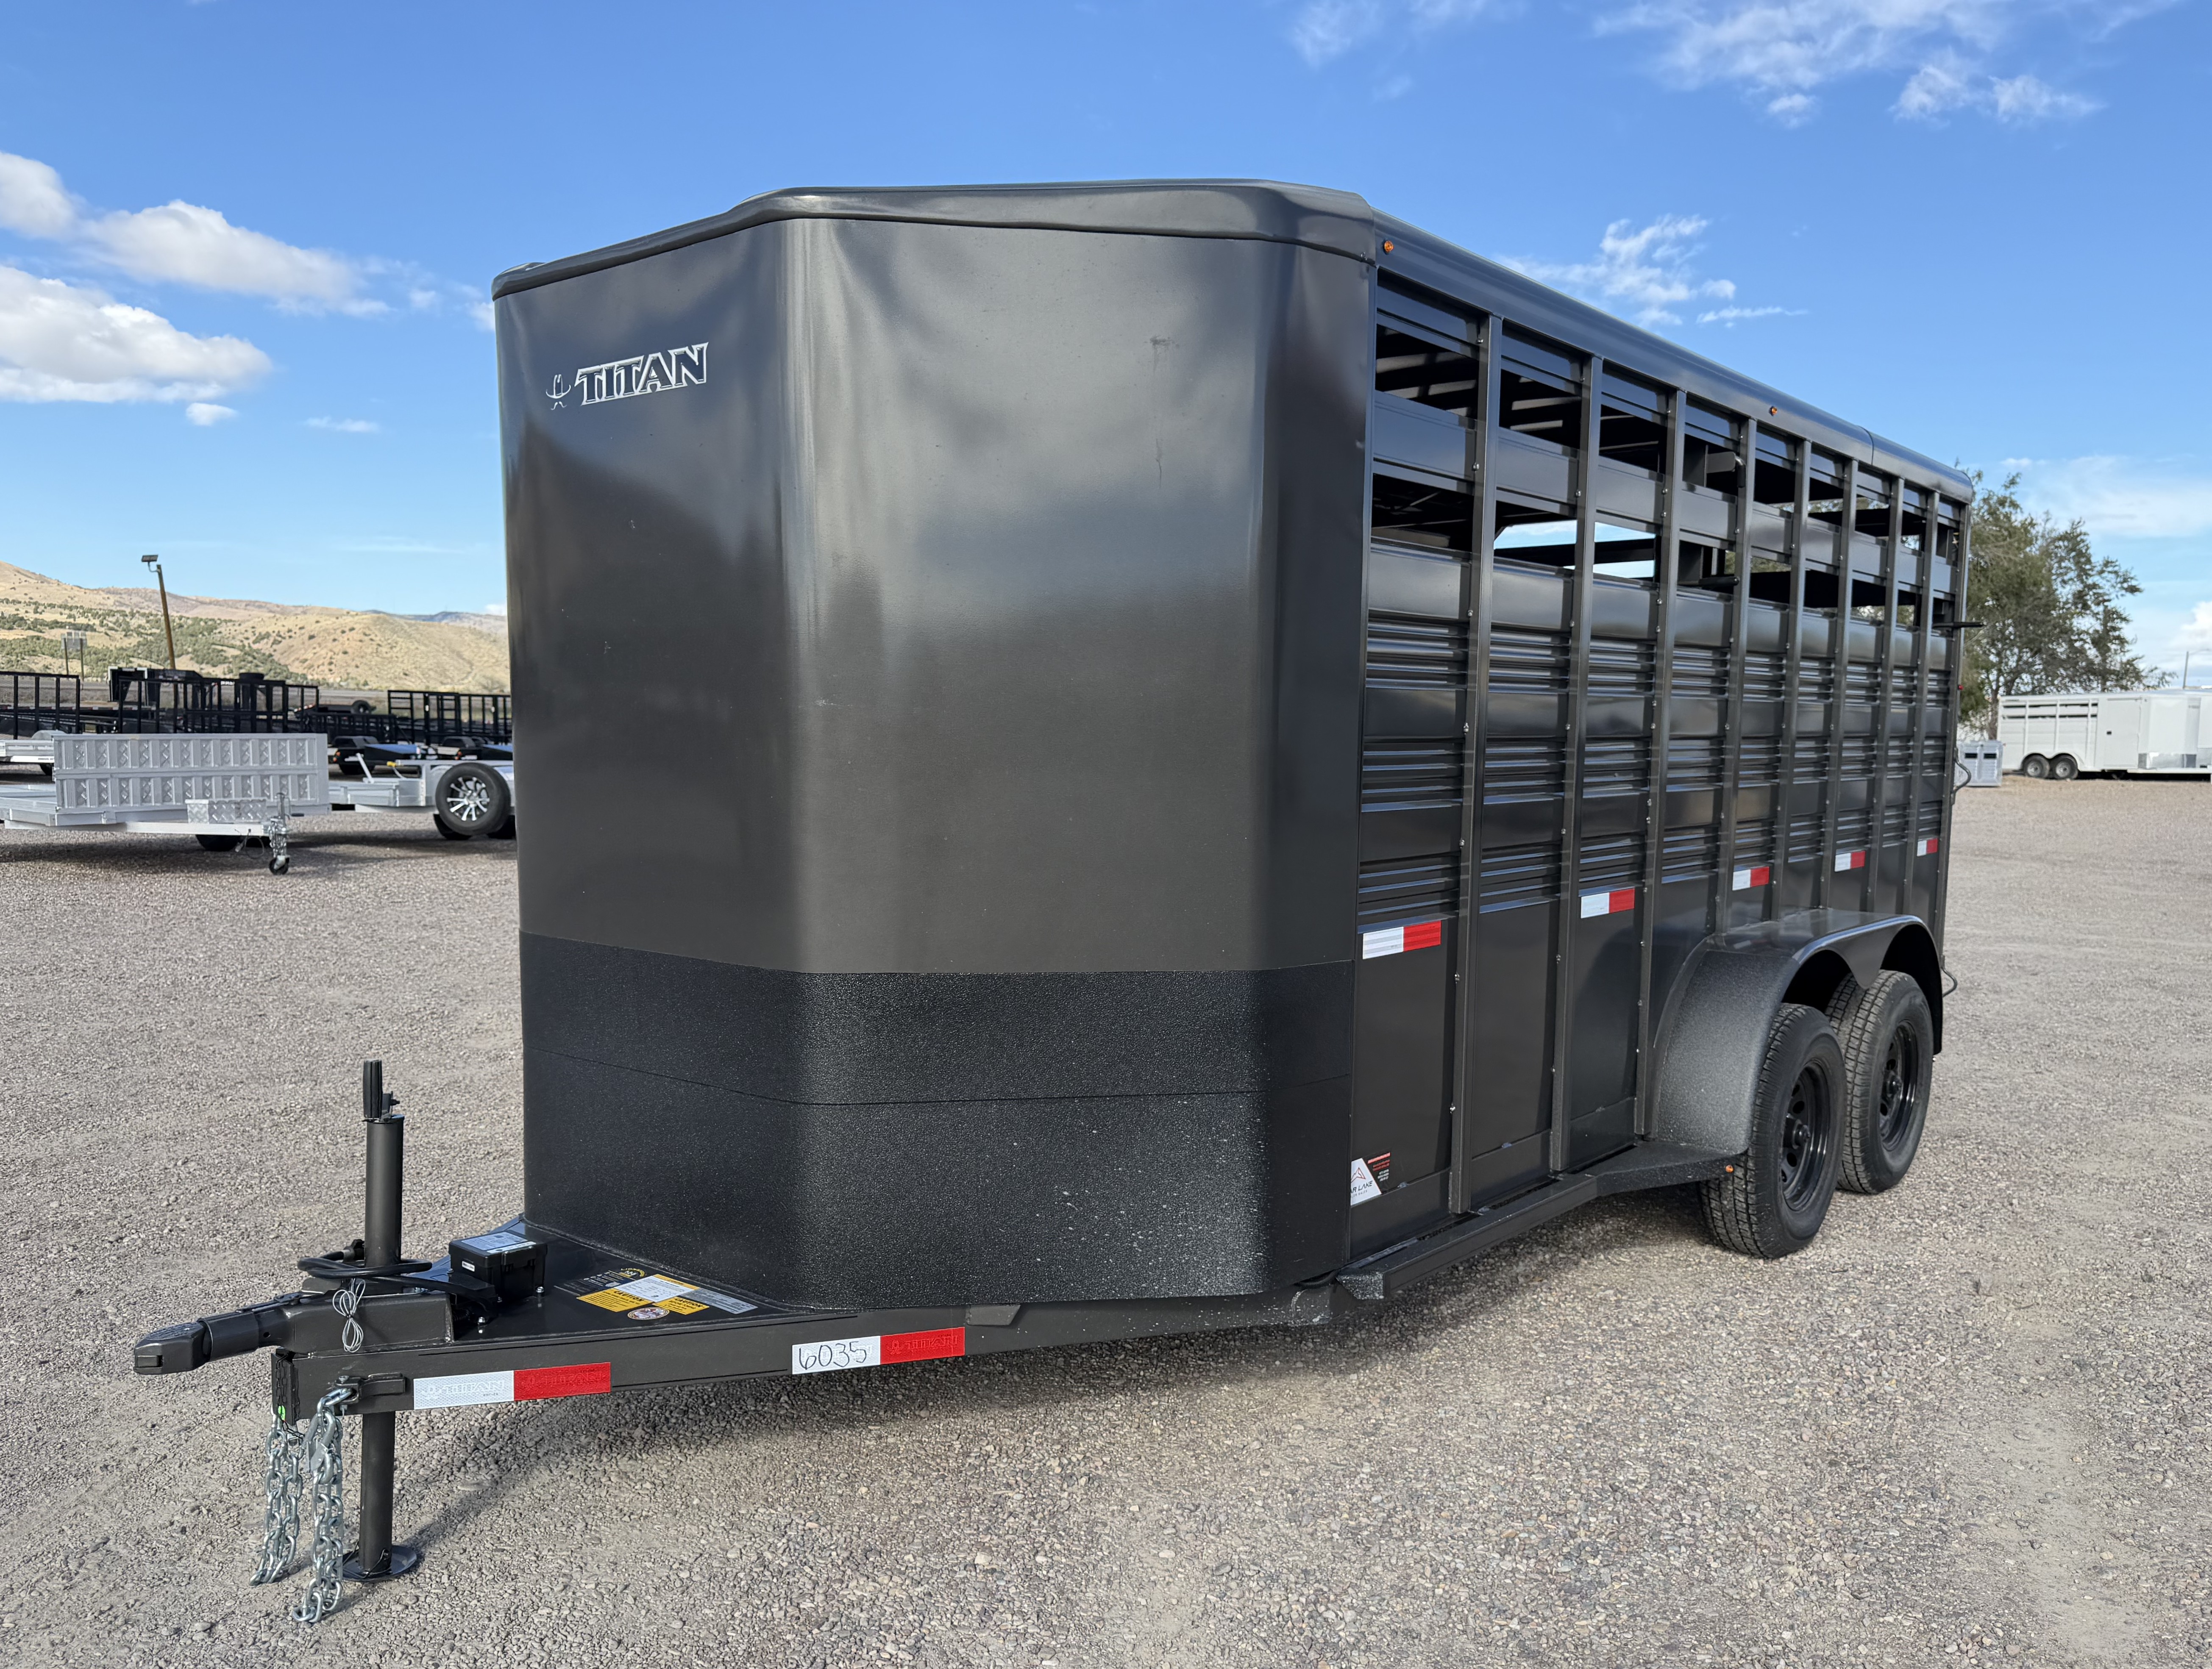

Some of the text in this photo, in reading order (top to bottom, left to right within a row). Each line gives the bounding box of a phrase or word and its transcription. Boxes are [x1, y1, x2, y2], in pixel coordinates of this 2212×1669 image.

[574, 342, 709, 406] TITAN
[1358, 1180, 1373, 1191] LAKE
[613, 1291, 645, 1302] CAUTION
[674, 1298, 704, 1308] CAUTION
[799, 1341, 867, 1370] 6035
[442, 1380, 505, 1395] TITAN
